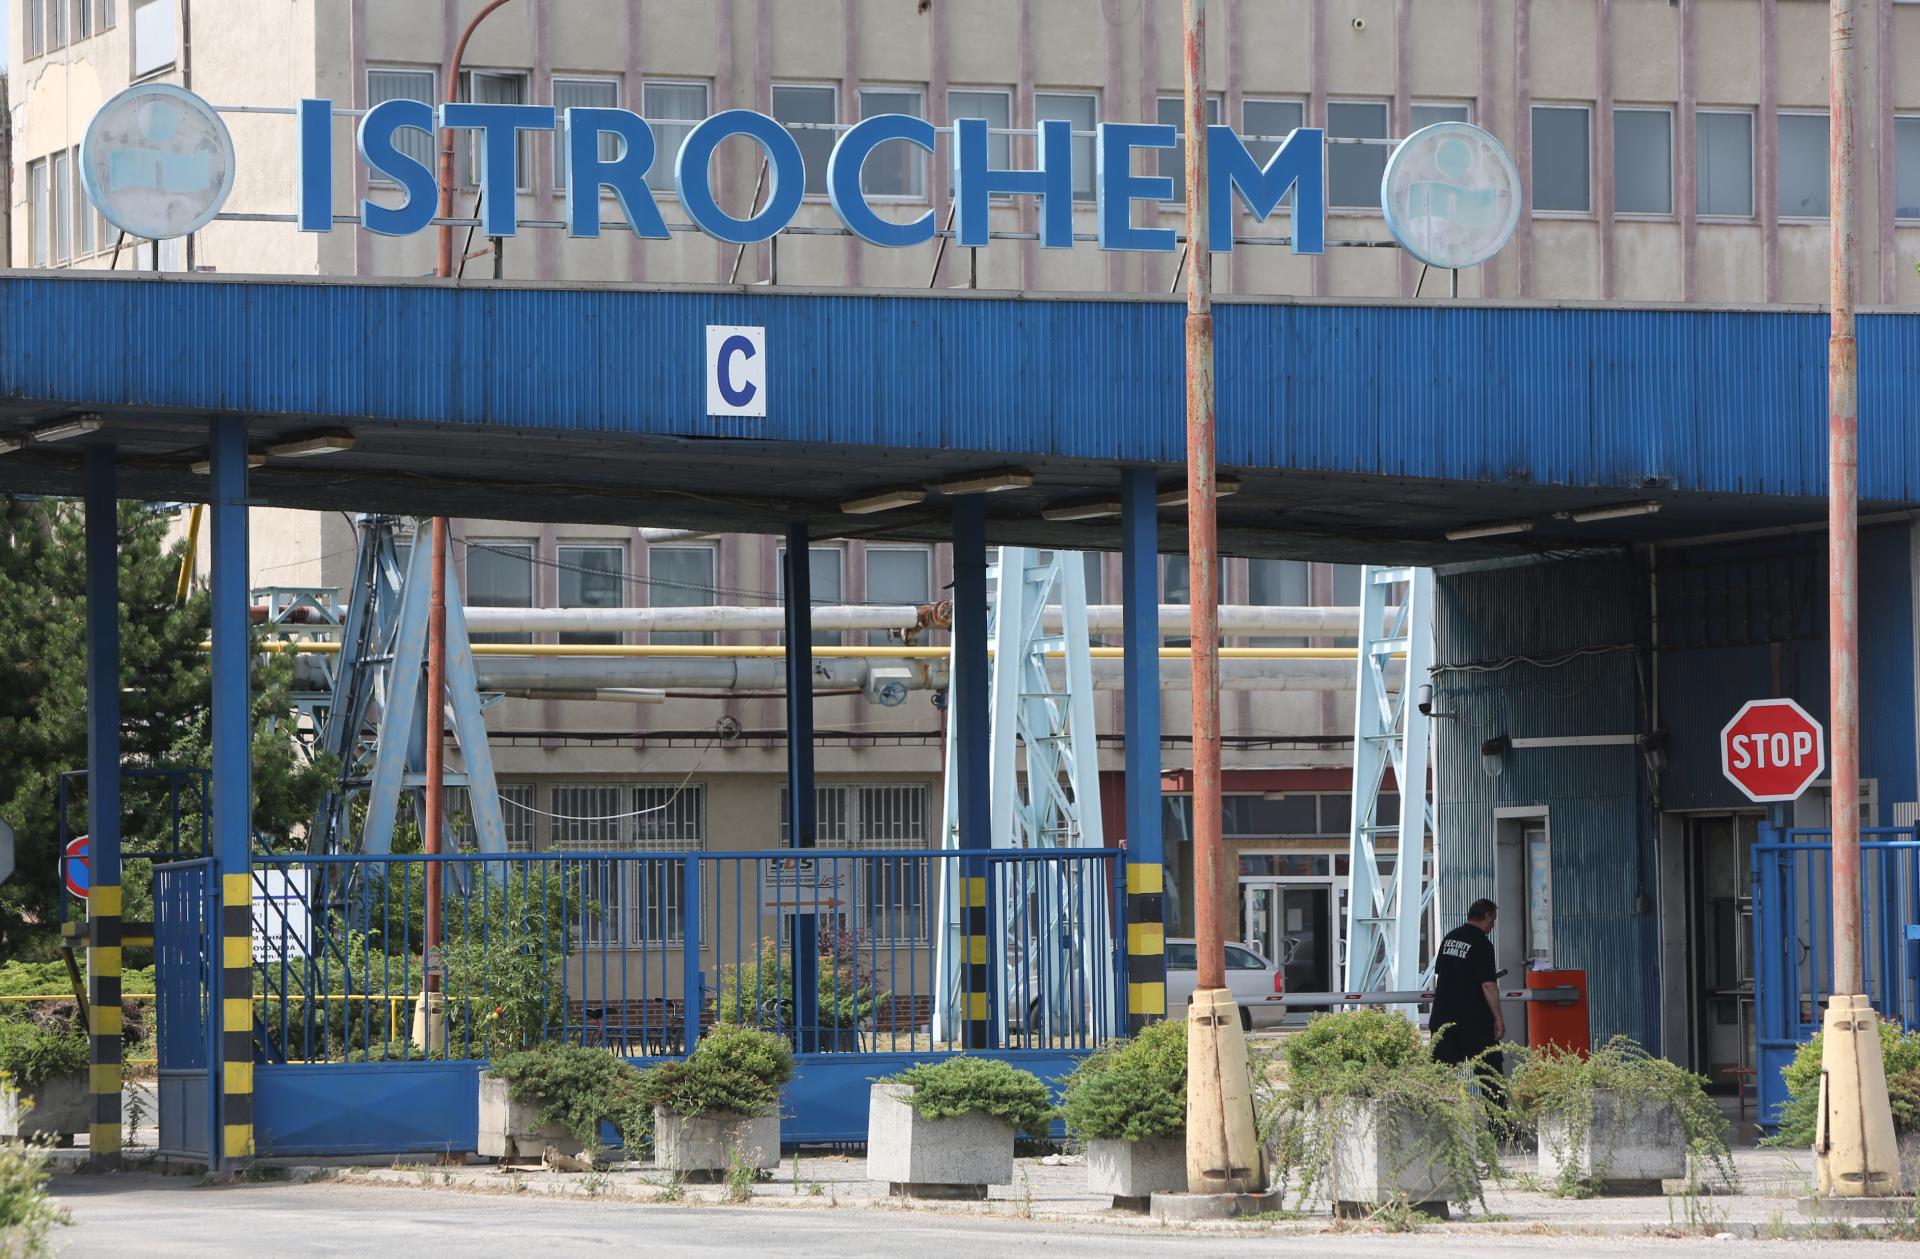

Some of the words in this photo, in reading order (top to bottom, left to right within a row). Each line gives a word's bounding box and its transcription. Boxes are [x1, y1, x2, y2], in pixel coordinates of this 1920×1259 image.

[297, 97, 1325, 255] ISTROCHEM
[717, 335, 757, 407] C
[1732, 731, 1812, 769] STOP
